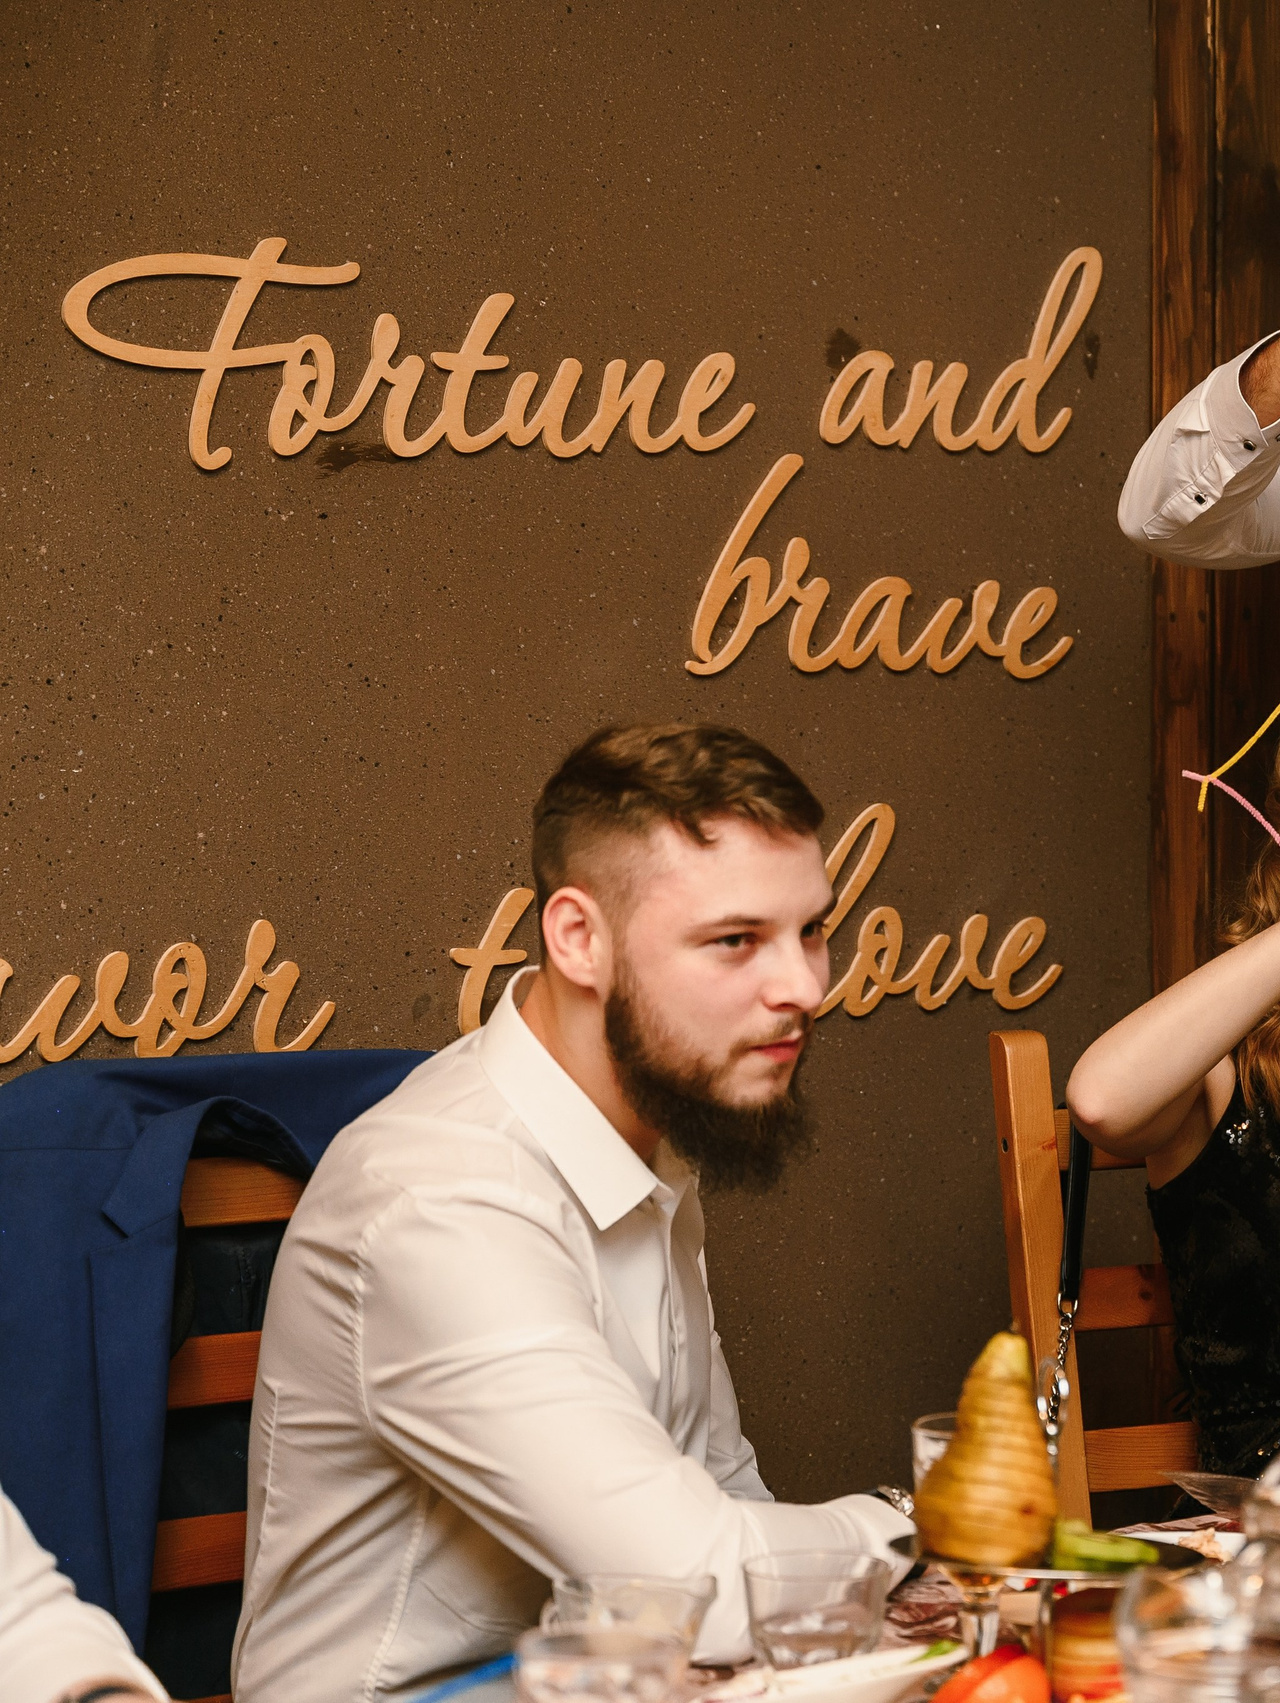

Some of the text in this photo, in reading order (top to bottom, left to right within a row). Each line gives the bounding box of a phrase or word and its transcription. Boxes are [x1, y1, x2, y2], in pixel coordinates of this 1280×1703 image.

[61, 237, 1103, 470] Fortune and
[685, 453, 1074, 679] brave
[0, 919, 336, 1063] vor
[814, 802, 1063, 1018] love
